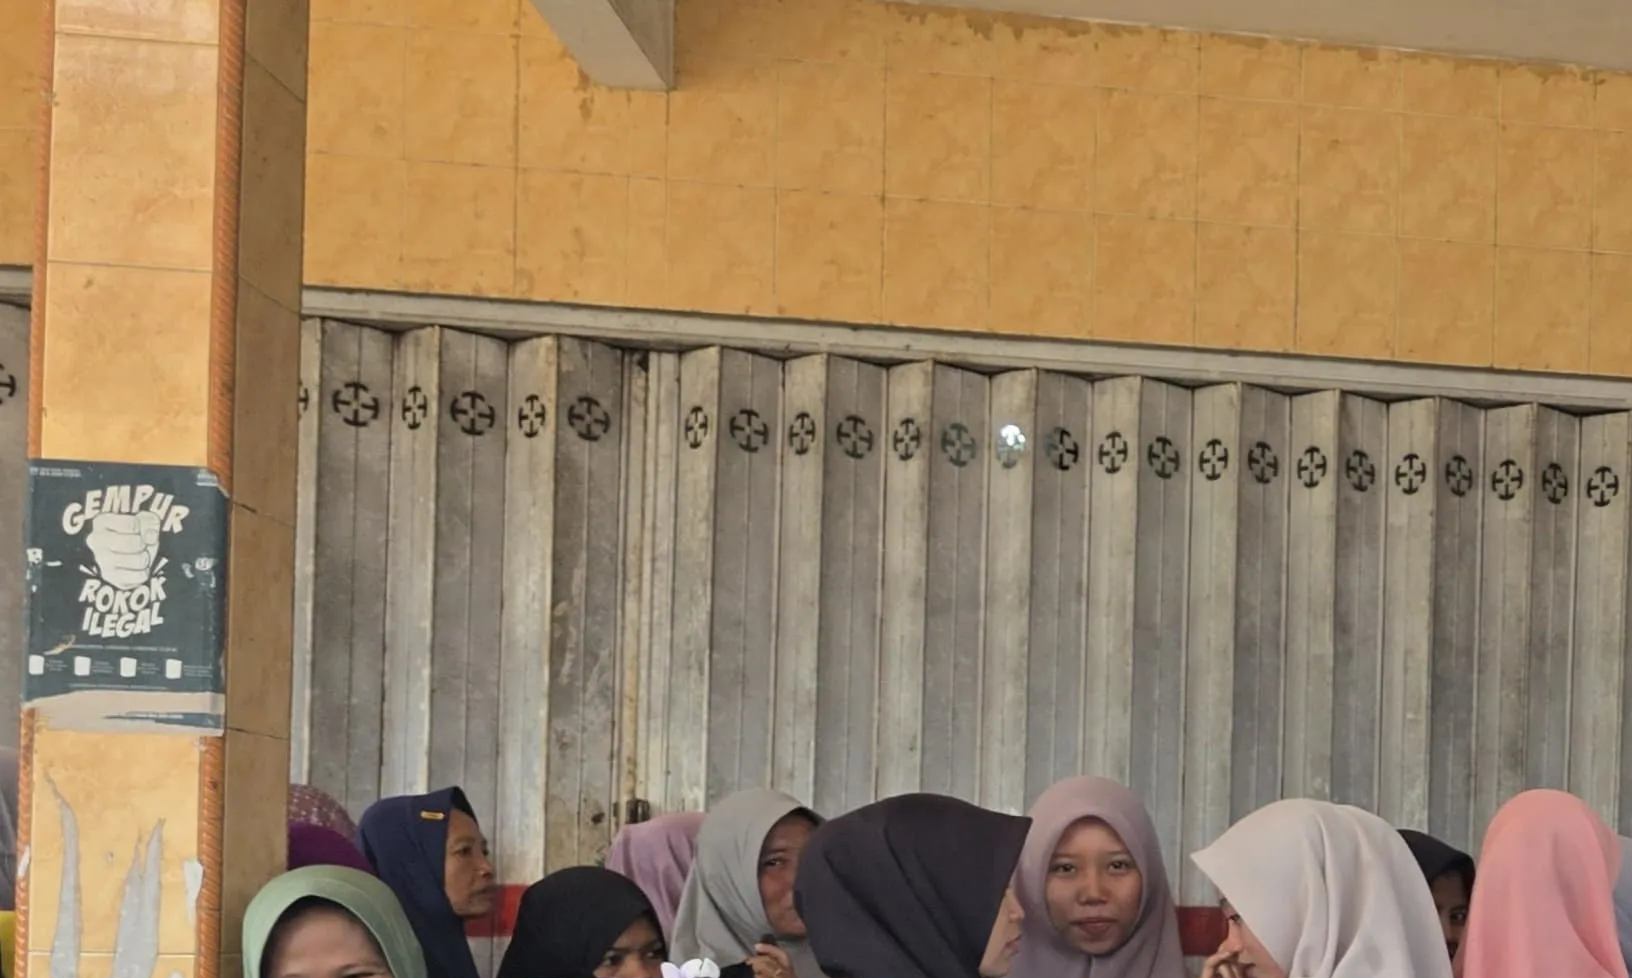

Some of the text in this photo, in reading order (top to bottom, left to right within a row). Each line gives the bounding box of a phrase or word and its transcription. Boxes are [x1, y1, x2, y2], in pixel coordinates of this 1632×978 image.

[62, 484, 190, 536] GEMPUR
[79, 576, 168, 614] ROKOK
[81, 601, 164, 639] ILEGAL
